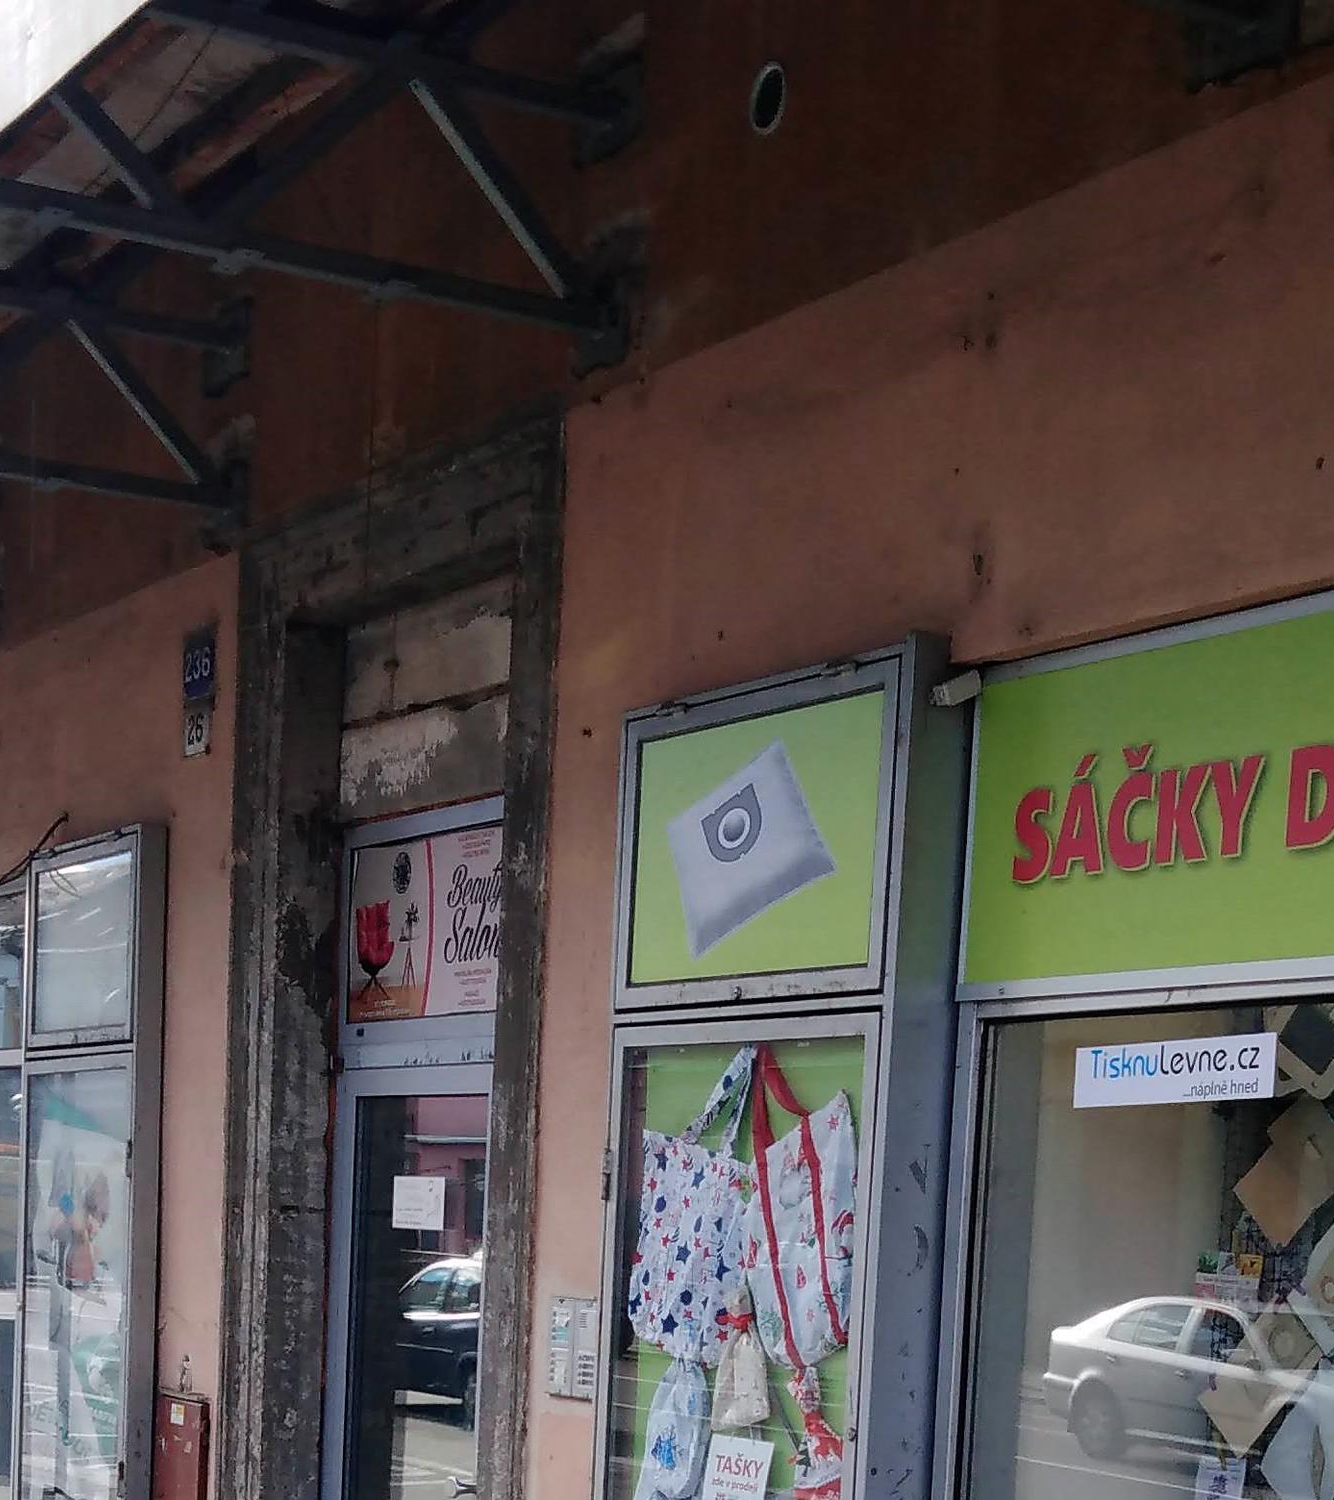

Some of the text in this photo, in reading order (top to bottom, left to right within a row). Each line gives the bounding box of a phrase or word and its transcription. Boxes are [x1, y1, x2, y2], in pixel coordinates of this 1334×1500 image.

[185, 646, 211, 682] 236
[187, 712, 205, 746] 26
[1012, 744, 1266, 884] SÁČKY
[447, 860, 503, 913] Beauty
[444, 897, 500, 963] Salon
[1230, 1078, 1259, 1095] hned
[716, 1453, 764, 1479] TAŠKY
